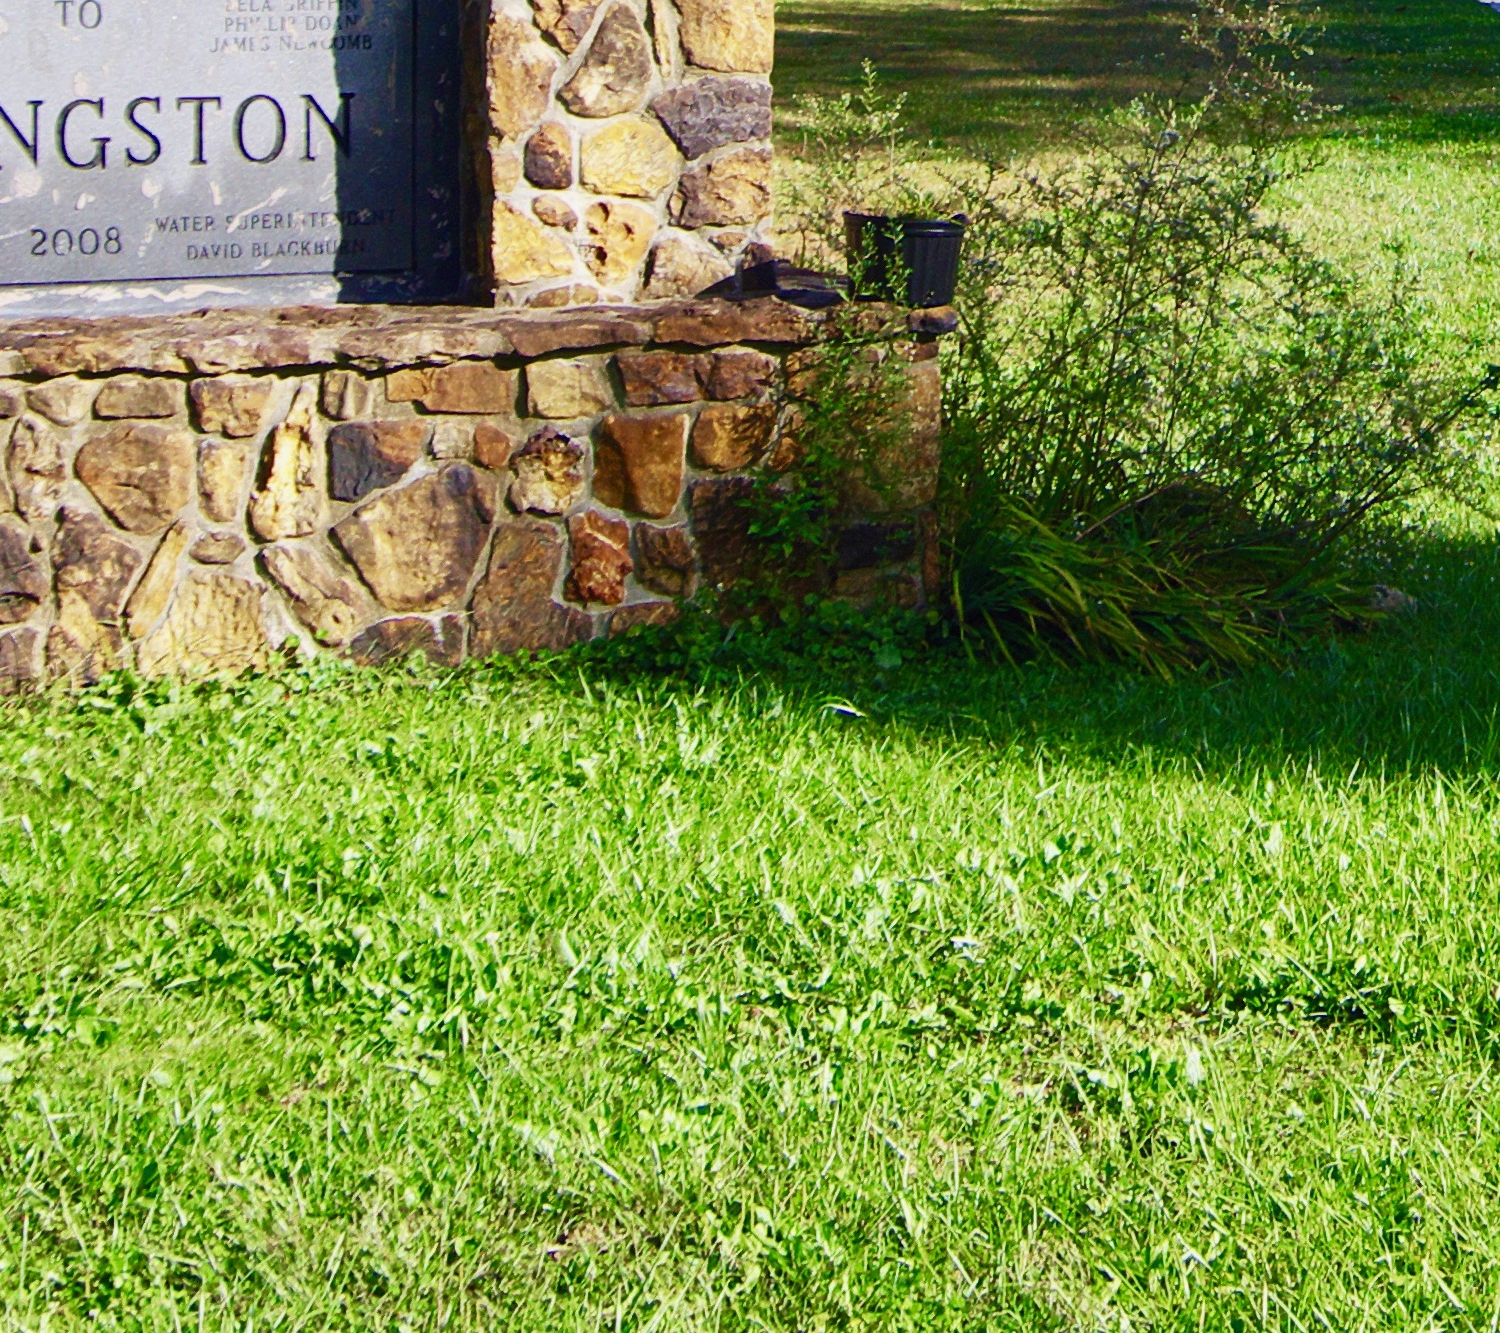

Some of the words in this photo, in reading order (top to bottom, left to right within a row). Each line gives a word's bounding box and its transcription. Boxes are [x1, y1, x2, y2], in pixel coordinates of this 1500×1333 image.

[54, 0, 103, 29] TO
[155, 216, 216, 233] WATER
[225, 209, 397, 232] SUPERITEDENT
[30, 226, 124, 257] 2008
[186, 244, 243, 261] DAVID
